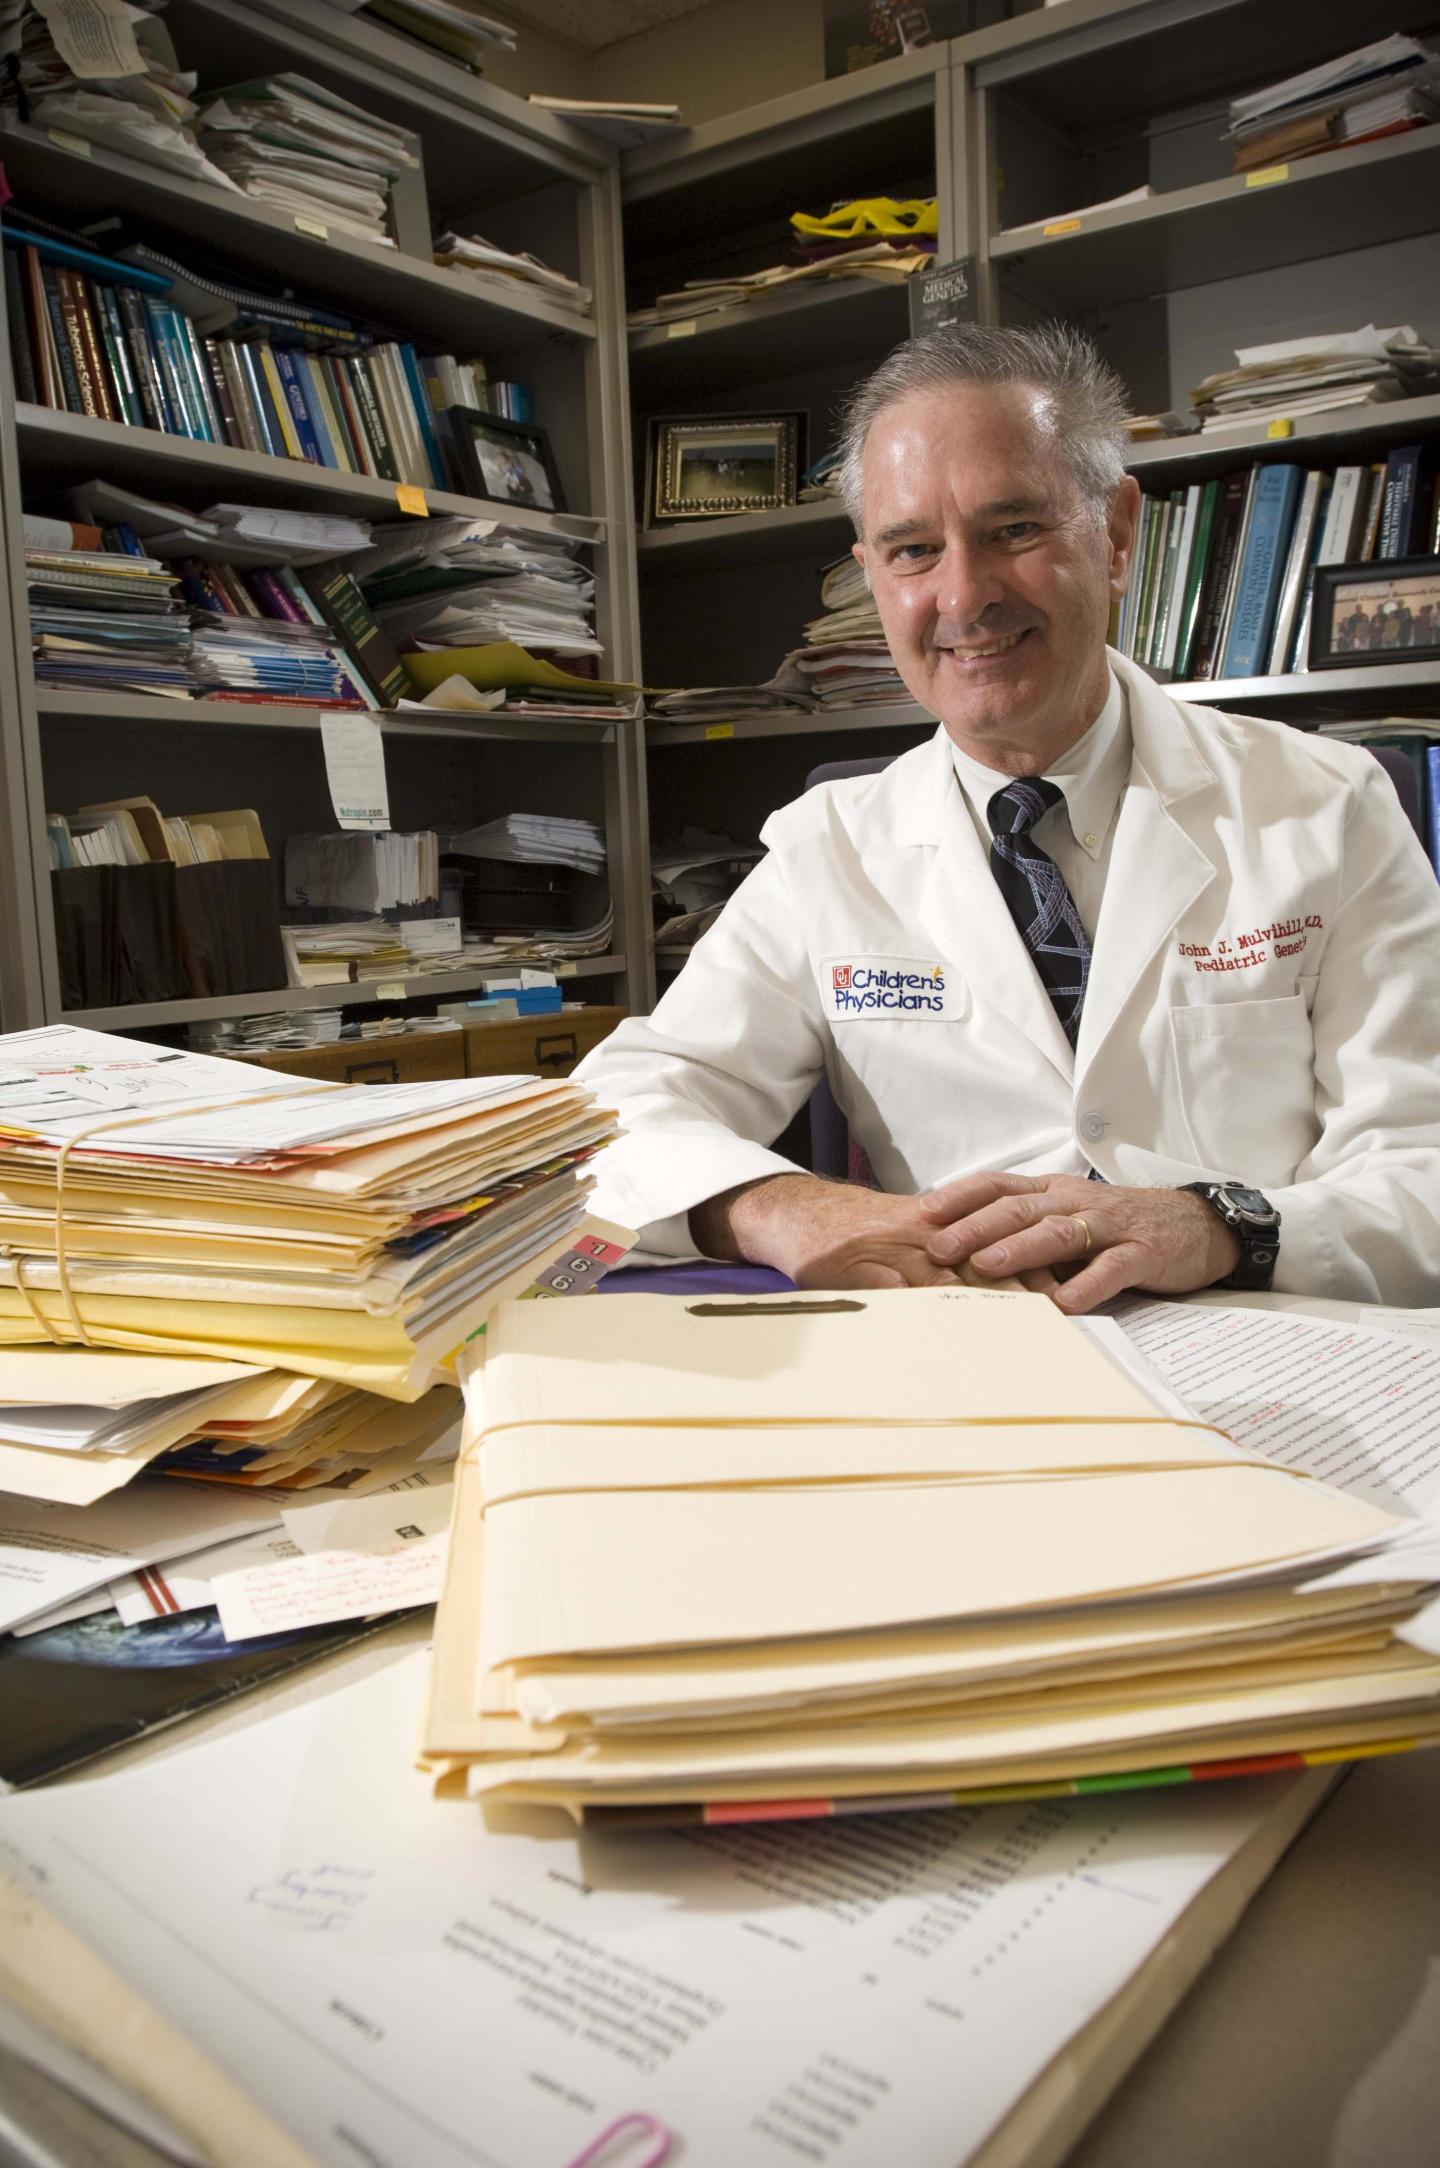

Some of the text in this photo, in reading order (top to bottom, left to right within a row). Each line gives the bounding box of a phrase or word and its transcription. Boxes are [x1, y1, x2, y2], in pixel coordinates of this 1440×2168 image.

[922, 283, 968, 304] GENETICS
[925, 270, 964, 293] MEDICAL
[1248, 536, 1265, 592] COMMON
[1260, 551, 1273, 601] GENETIC
[1238, 592, 1255, 641] DISEASES
[1179, 942, 1212, 957] John
[1218, 940, 1233, 954] J.
[1237, 918, 1304, 950] Mulvihill,
[1195, 949, 1267, 972] Pediatric
[835, 988, 944, 1013] Physicians
